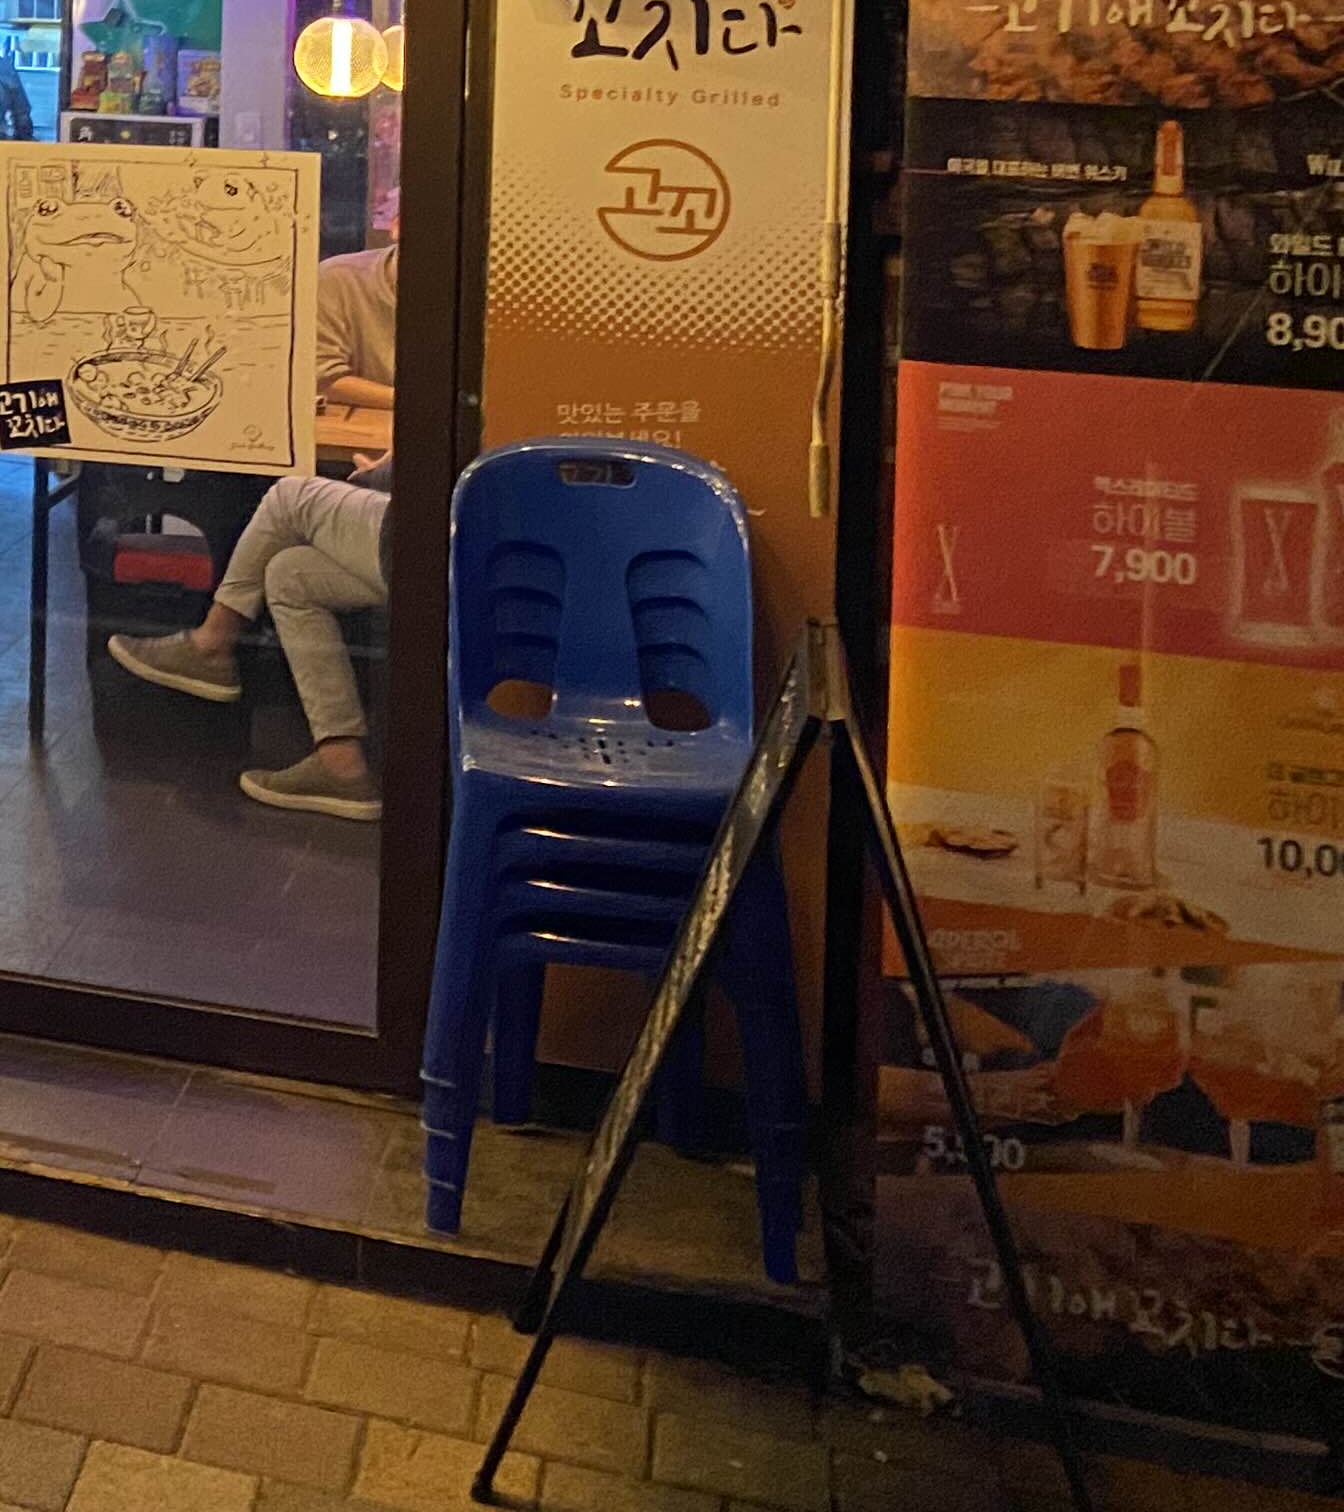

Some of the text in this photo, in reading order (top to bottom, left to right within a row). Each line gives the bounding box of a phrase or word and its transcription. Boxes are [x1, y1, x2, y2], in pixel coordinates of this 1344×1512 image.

[559, 83, 781, 108] Specialty Grilled
[6, 413, 66, 439] 꼬치다
[557, 399, 702, 426] 맛있는 주문을
[1091, 503, 1197, 544] 하이볼
[1090, 544, 1198, 586] 7,900
